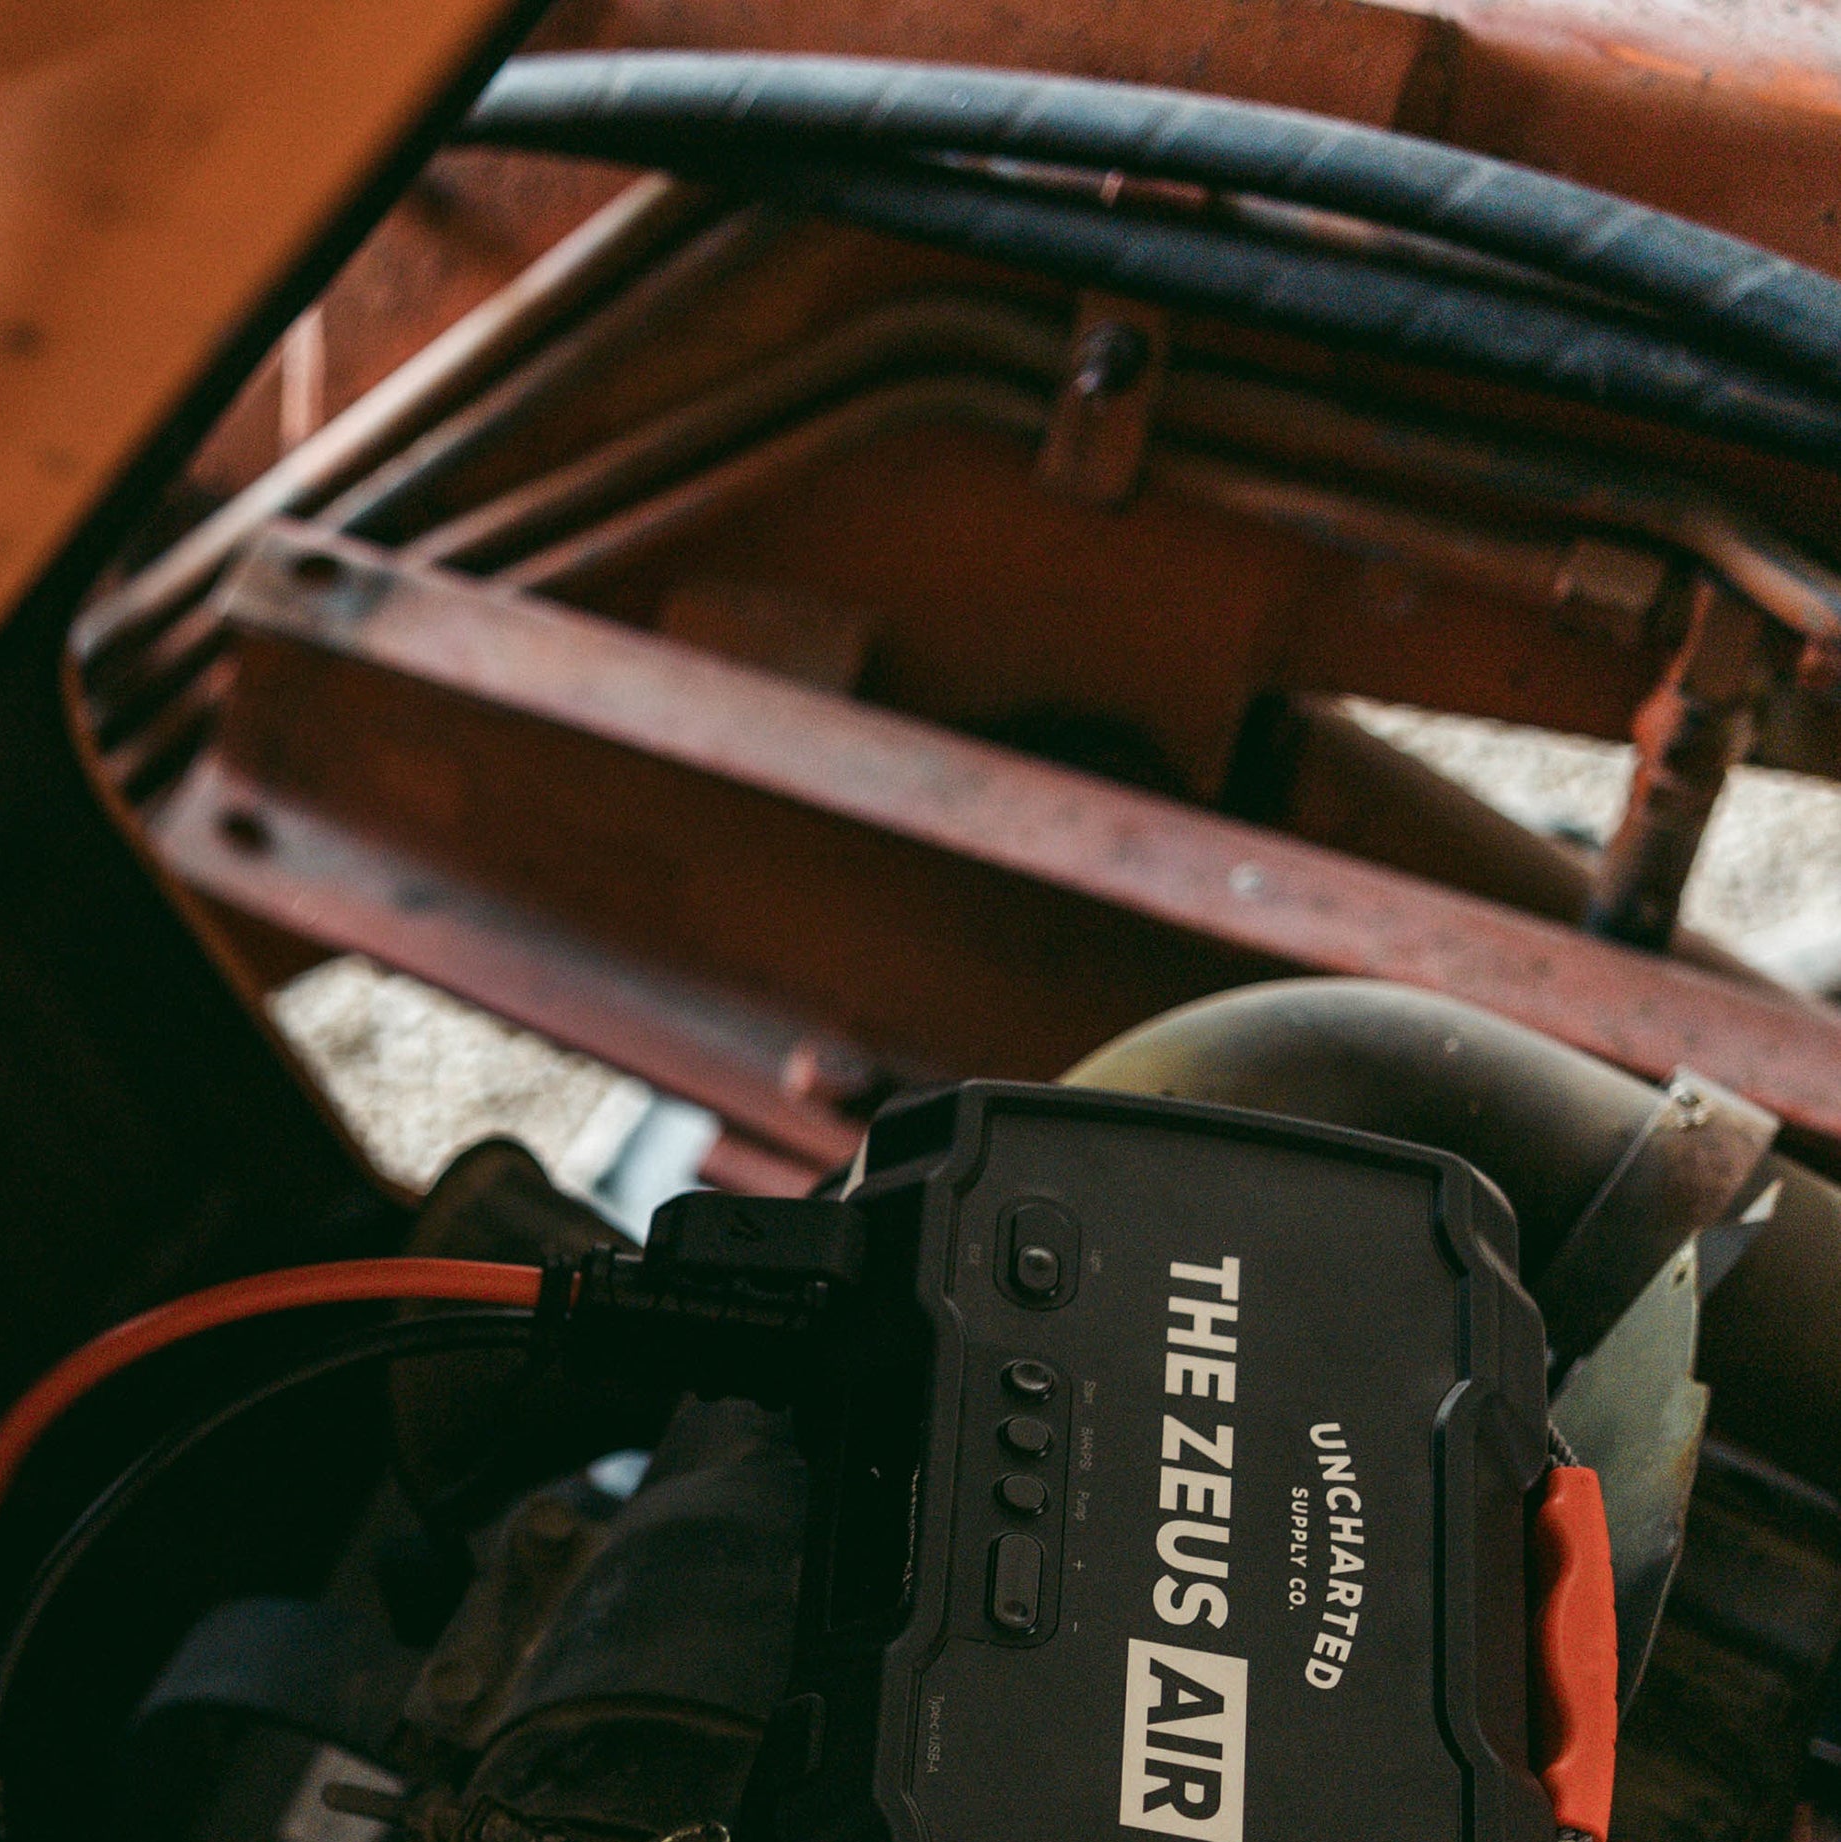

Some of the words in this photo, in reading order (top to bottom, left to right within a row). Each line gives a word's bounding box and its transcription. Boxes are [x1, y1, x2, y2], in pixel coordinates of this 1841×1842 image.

[1164, 1256, 1240, 1403] THE
[1073, 1491, 1091, 1521] Pump
[1152, 1414, 1234, 1629] ZEUS
[1290, 1486, 1309, 1568] SUPPLY
[1305, 1422, 1365, 1690] UNCHARTED
[1288, 1577, 1307, 1611] CO.
[1142, 1657, 1225, 1821] AIR
